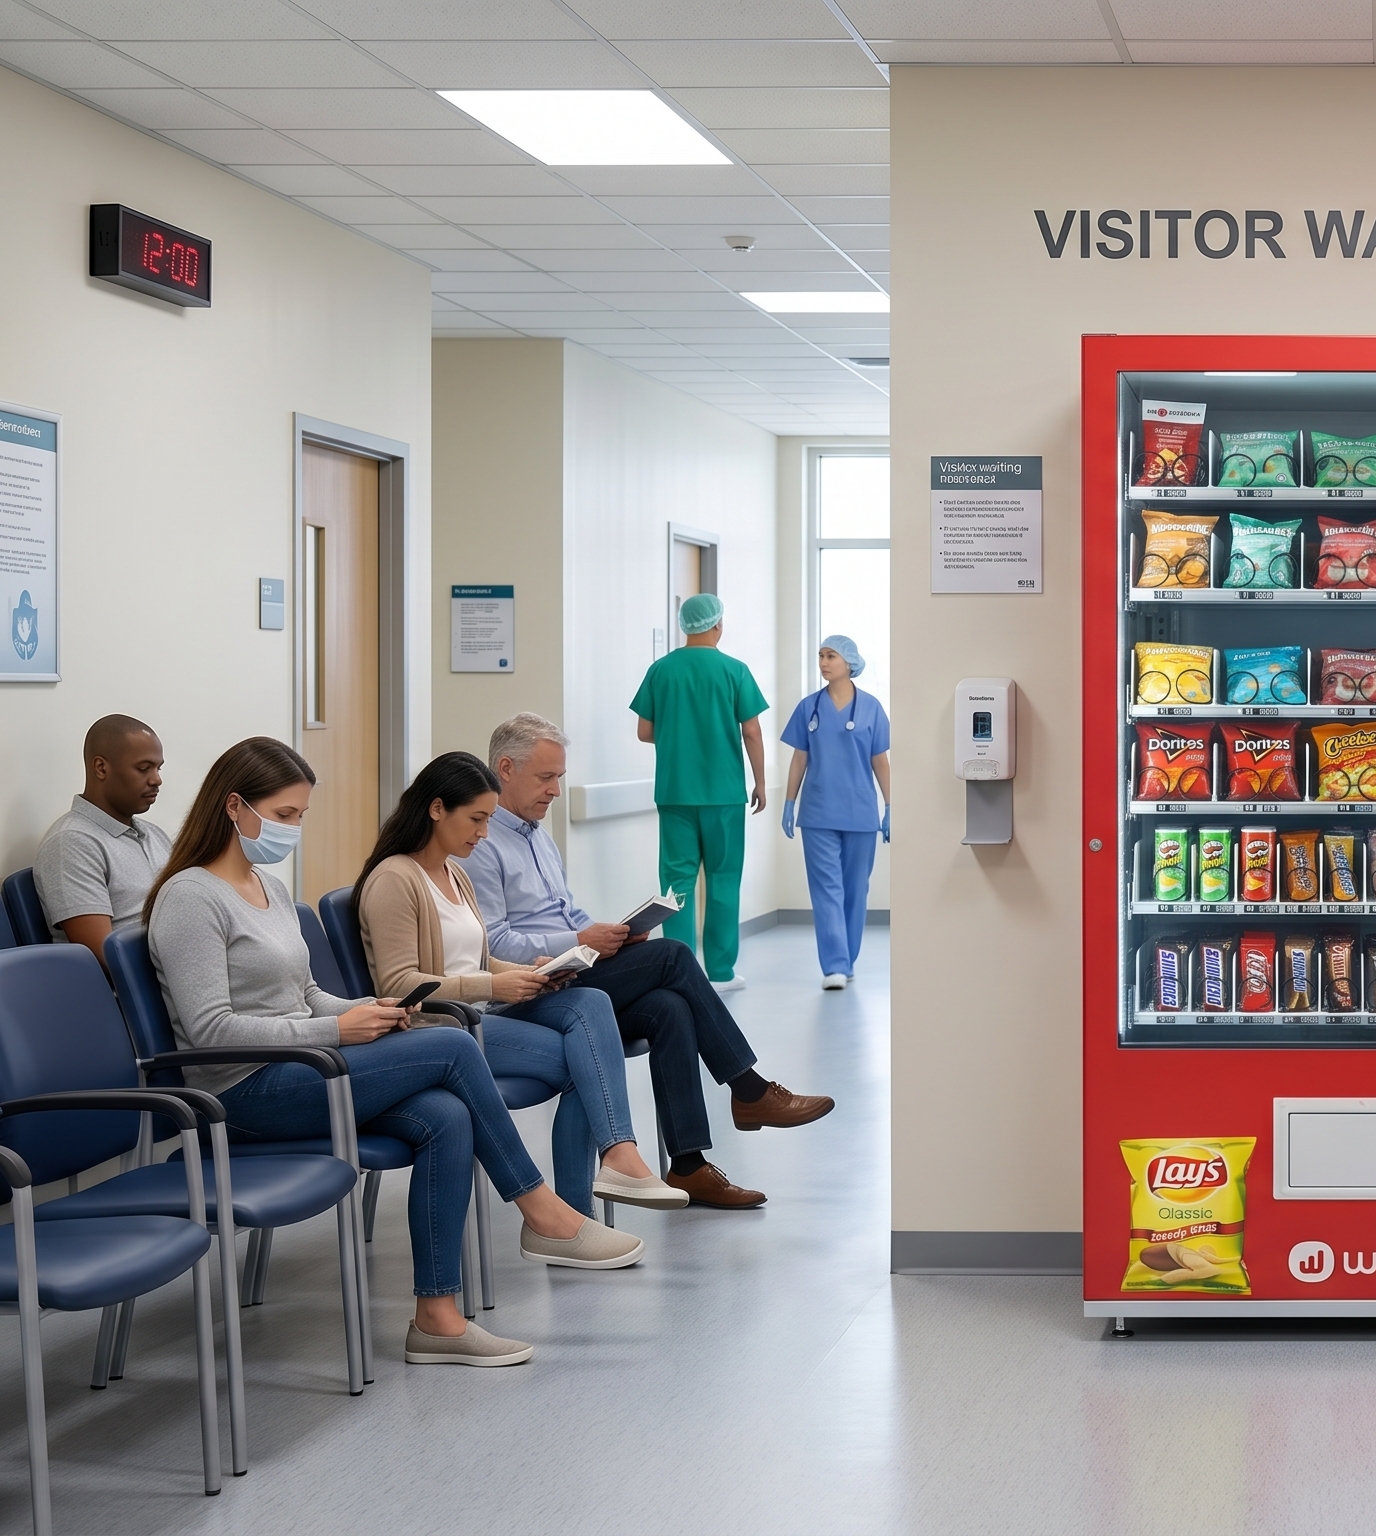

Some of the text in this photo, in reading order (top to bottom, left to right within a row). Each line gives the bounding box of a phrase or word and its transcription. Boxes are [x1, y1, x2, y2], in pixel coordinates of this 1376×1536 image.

[143, 232, 199, 287] 12:00
[1034, 209, 1286, 260] VISITOR
[1152, 1157, 1223, 1190] Lay's
